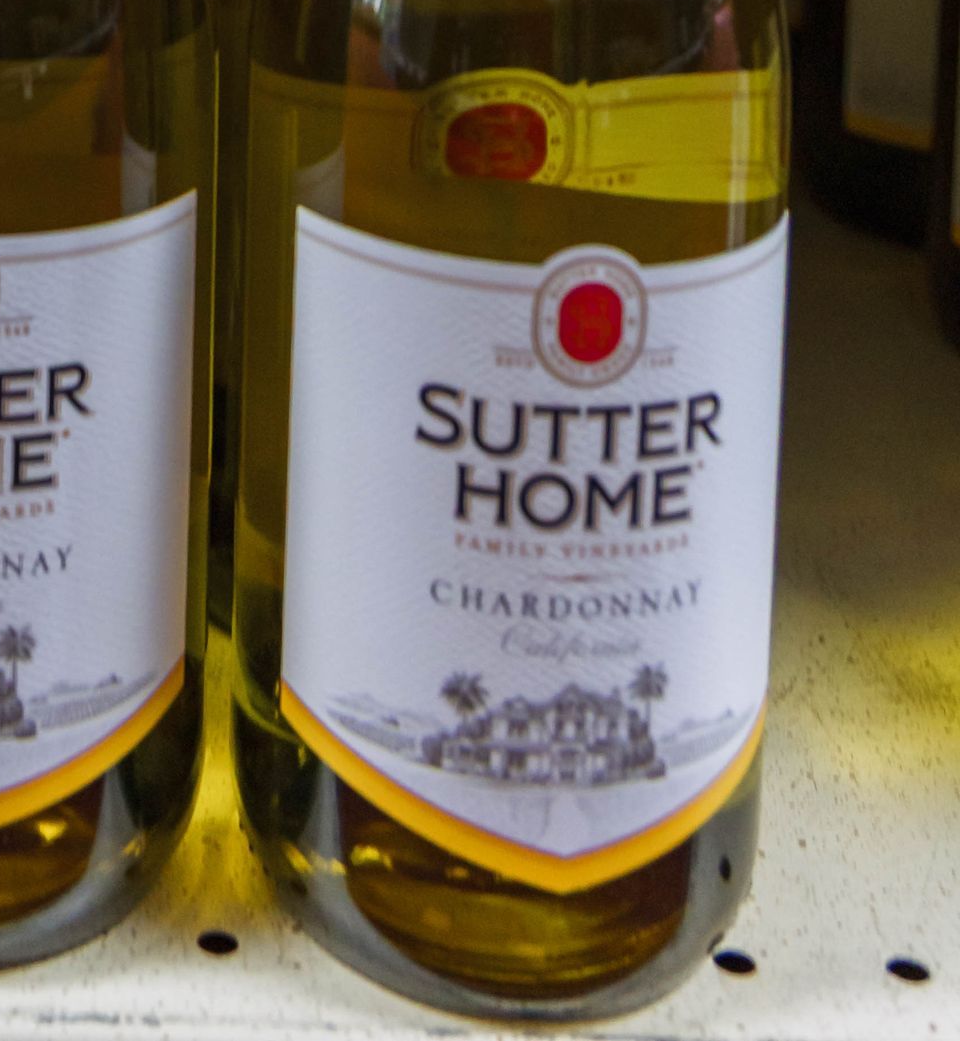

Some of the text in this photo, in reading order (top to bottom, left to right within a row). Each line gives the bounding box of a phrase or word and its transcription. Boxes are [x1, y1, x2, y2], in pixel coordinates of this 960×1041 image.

[415, 383, 723, 463] SUTTER
[453, 462, 694, 533] HOME
[454, 532, 689, 559] FAMILY VINEYARDS
[430, 578, 701, 621] CHARDONNAY
